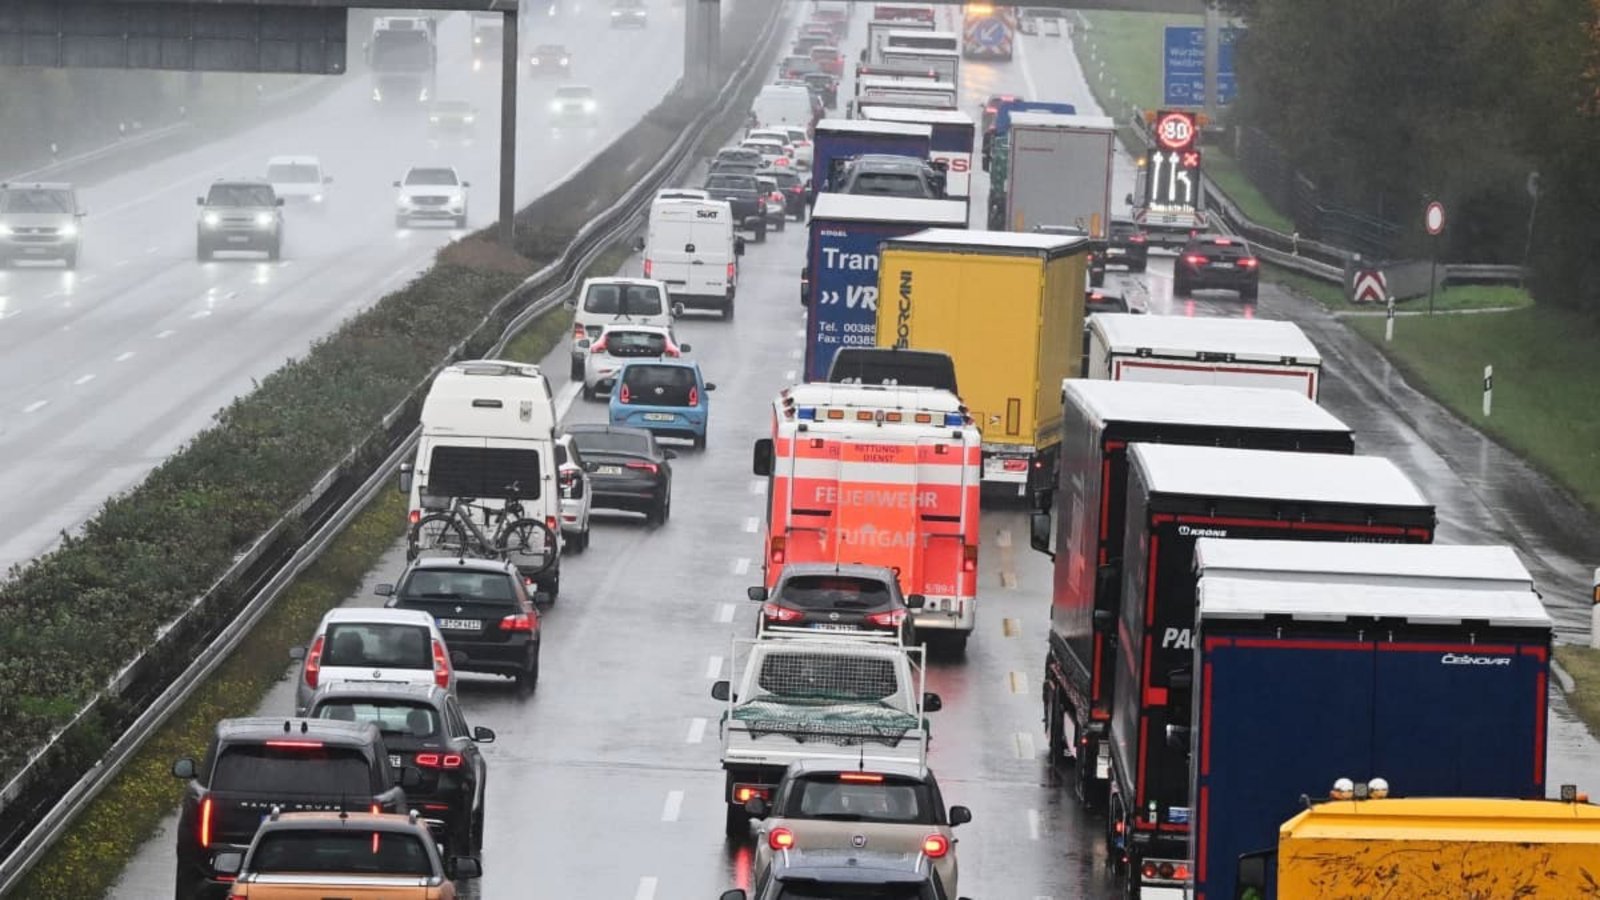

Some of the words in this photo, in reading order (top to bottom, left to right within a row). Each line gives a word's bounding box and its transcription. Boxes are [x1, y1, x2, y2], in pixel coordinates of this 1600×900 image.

[1166, 121, 1188, 140] 80
[823, 248, 878, 270] Tran
[819, 321, 838, 332] Tel.
[863, 454, 895, 462] DIENST
[815, 486, 937, 508] FEUERWEHR
[1190, 528, 1227, 537] KRONE
[1162, 627, 1196, 649] PA
